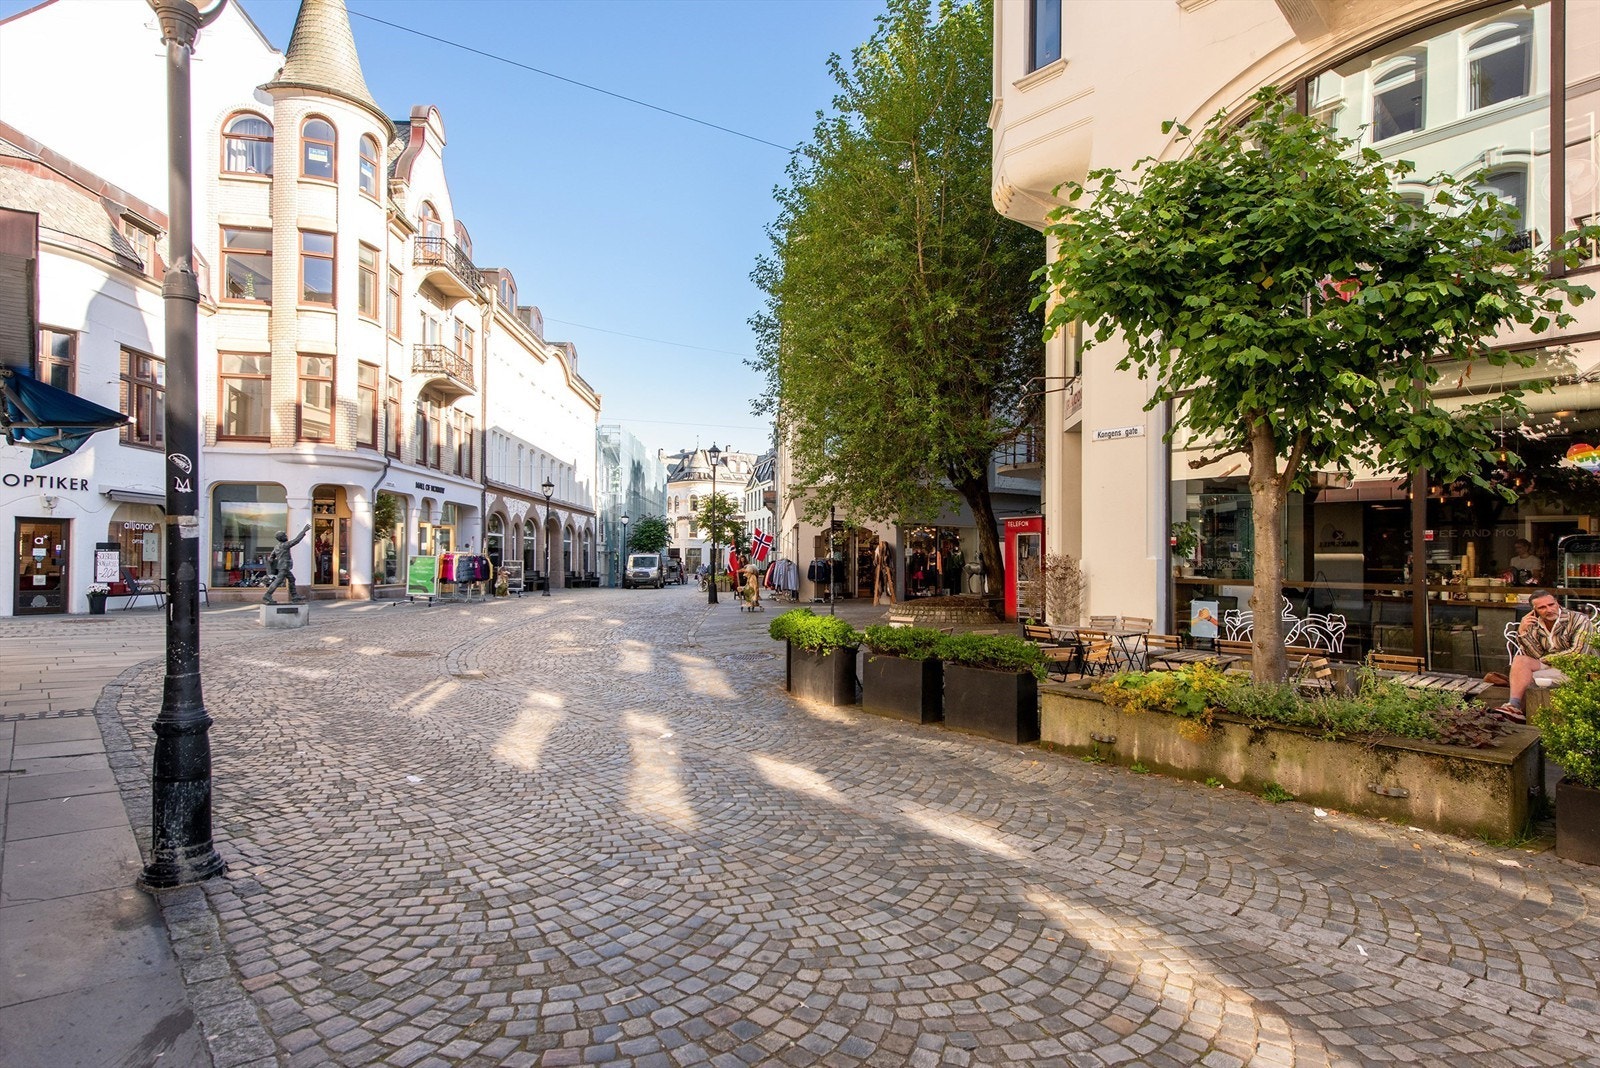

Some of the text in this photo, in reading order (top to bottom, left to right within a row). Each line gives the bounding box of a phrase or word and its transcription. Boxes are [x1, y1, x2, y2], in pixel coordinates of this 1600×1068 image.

[1097, 427, 1138, 439] Kongens gate
[3, 473, 89, 491] OPTIKER
[124, 520, 153, 531] alliance
[1463, 529, 1491, 537] AND
